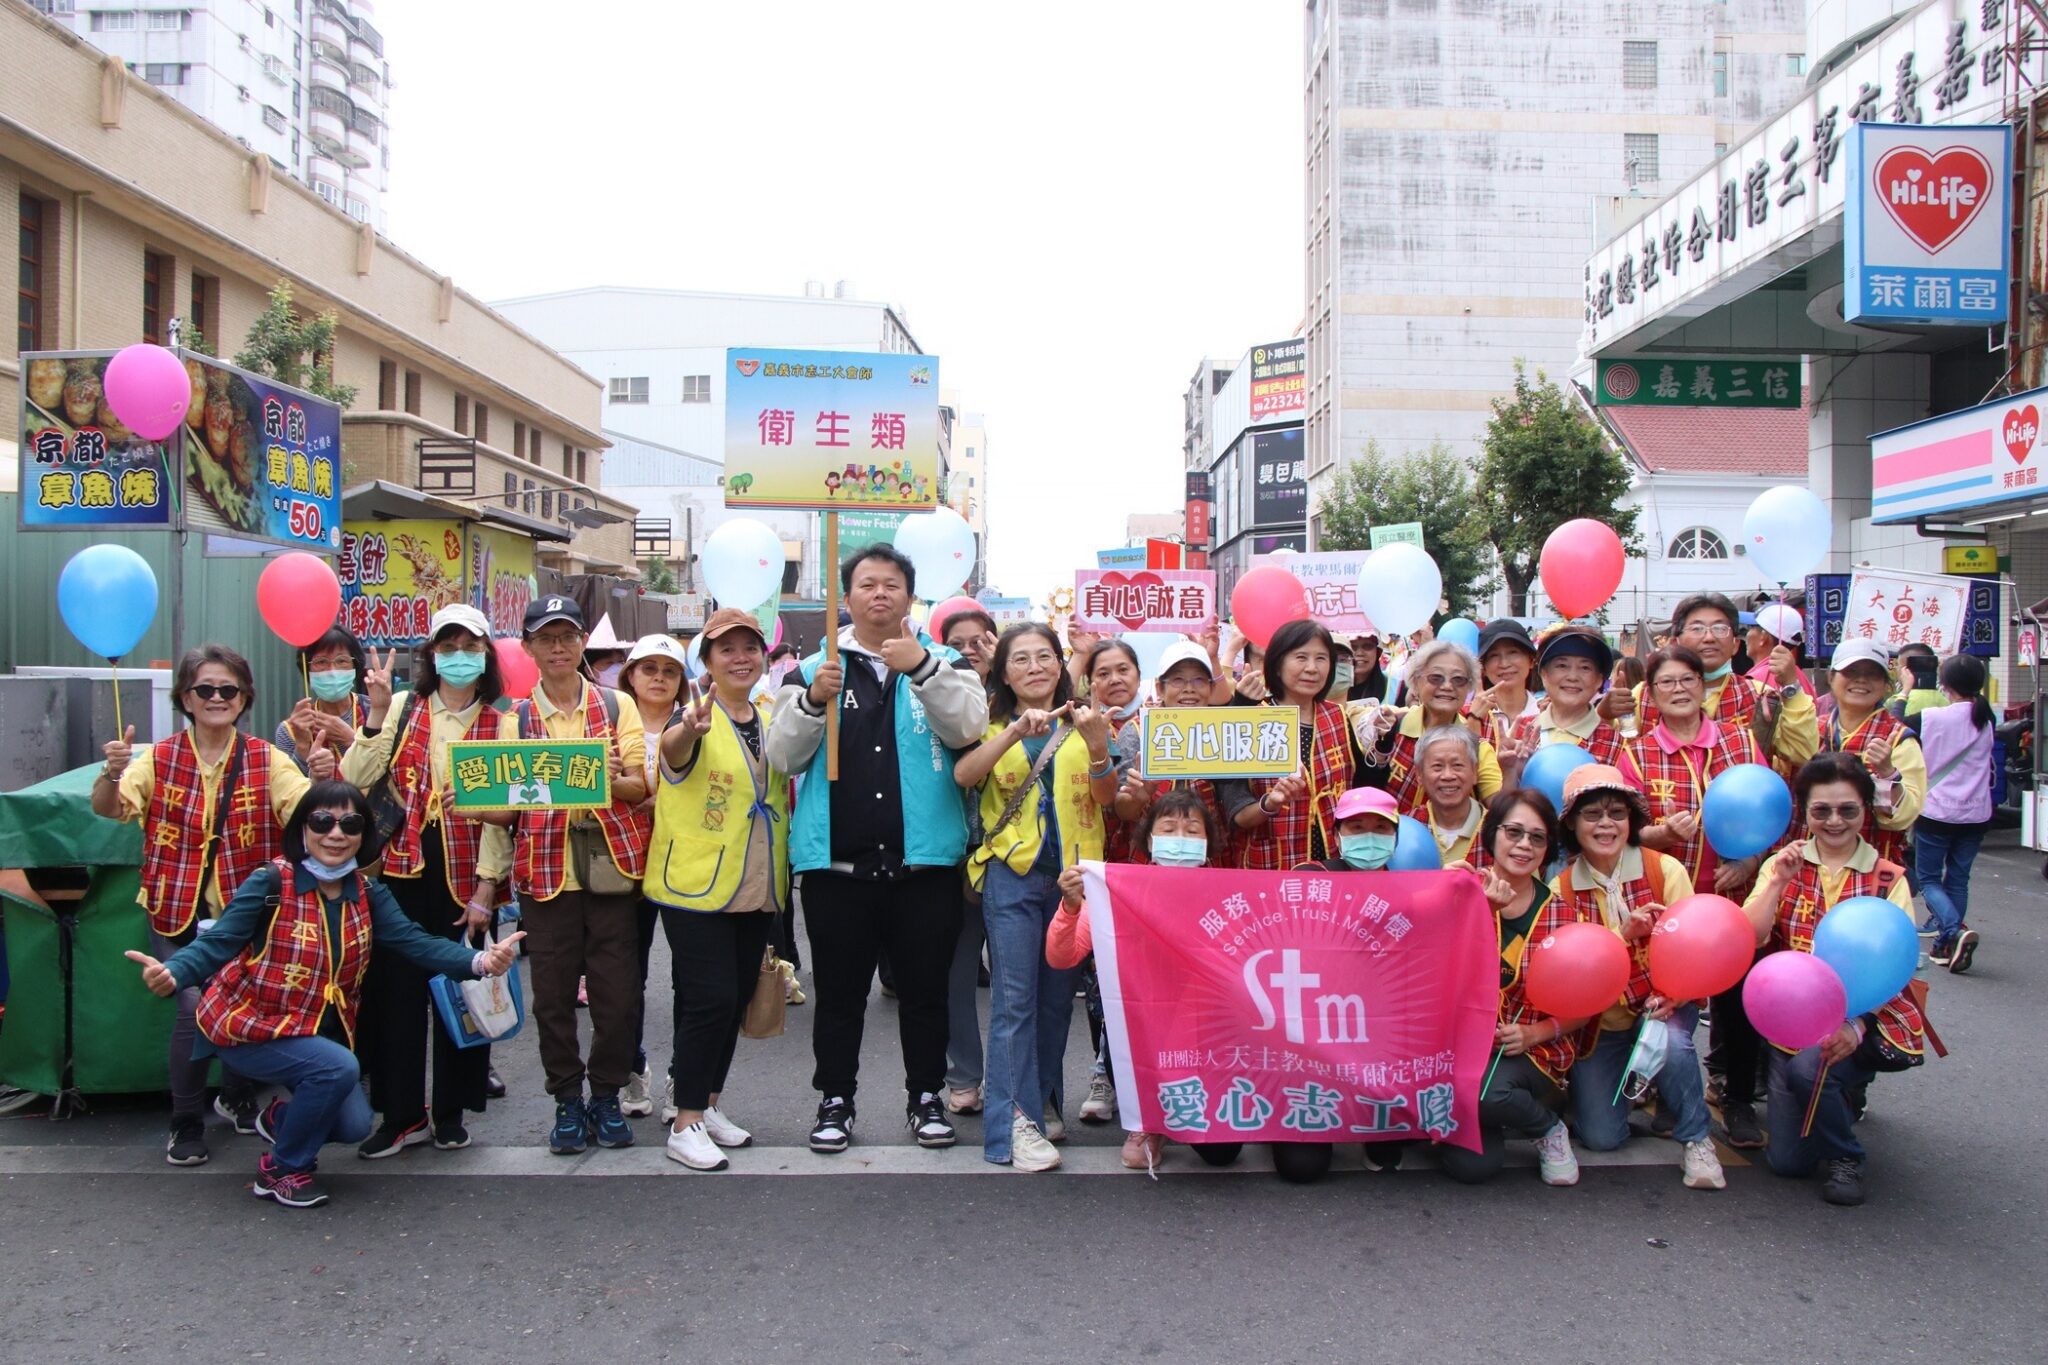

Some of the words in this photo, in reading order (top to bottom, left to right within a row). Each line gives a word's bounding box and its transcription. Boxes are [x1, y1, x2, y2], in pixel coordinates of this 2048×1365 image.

[1891, 168, 1977, 220] Hi-Life
[1869, 274, 1998, 311] 萊爾富
[763, 362, 873, 381] 嘉義市志工大會師
[1254, 378, 1305, 396] 廣告出
[1651, 364, 1790, 401] 嘉義三信
[264, 398, 306, 445] 京都
[758, 408, 906, 450] 衛生類
[2006, 420, 2036, 449] Hi-Life
[35, 431, 105, 464] 京都
[38, 468, 159, 508] 章魚燒
[267, 444, 333, 499] 章魚燒
[2004, 467, 2037, 488] 萊爾富
[289, 500, 321, 539] 50
[1084, 584, 1205, 620] 真心誠意
[1973, 587, 1993, 644] 日船
[1858, 617, 1943, 648] 香酥雞
[843, 689, 859, 709] A
[1152, 721, 1290, 762] 全心服務
[455, 751, 603, 793] 愛心奉獻
[154, 784, 185, 850] 平安
[234, 786, 258, 848] 主佑
[283, 919, 318, 990] 平安
[1157, 1075, 1459, 1138] 愛心志工隊
